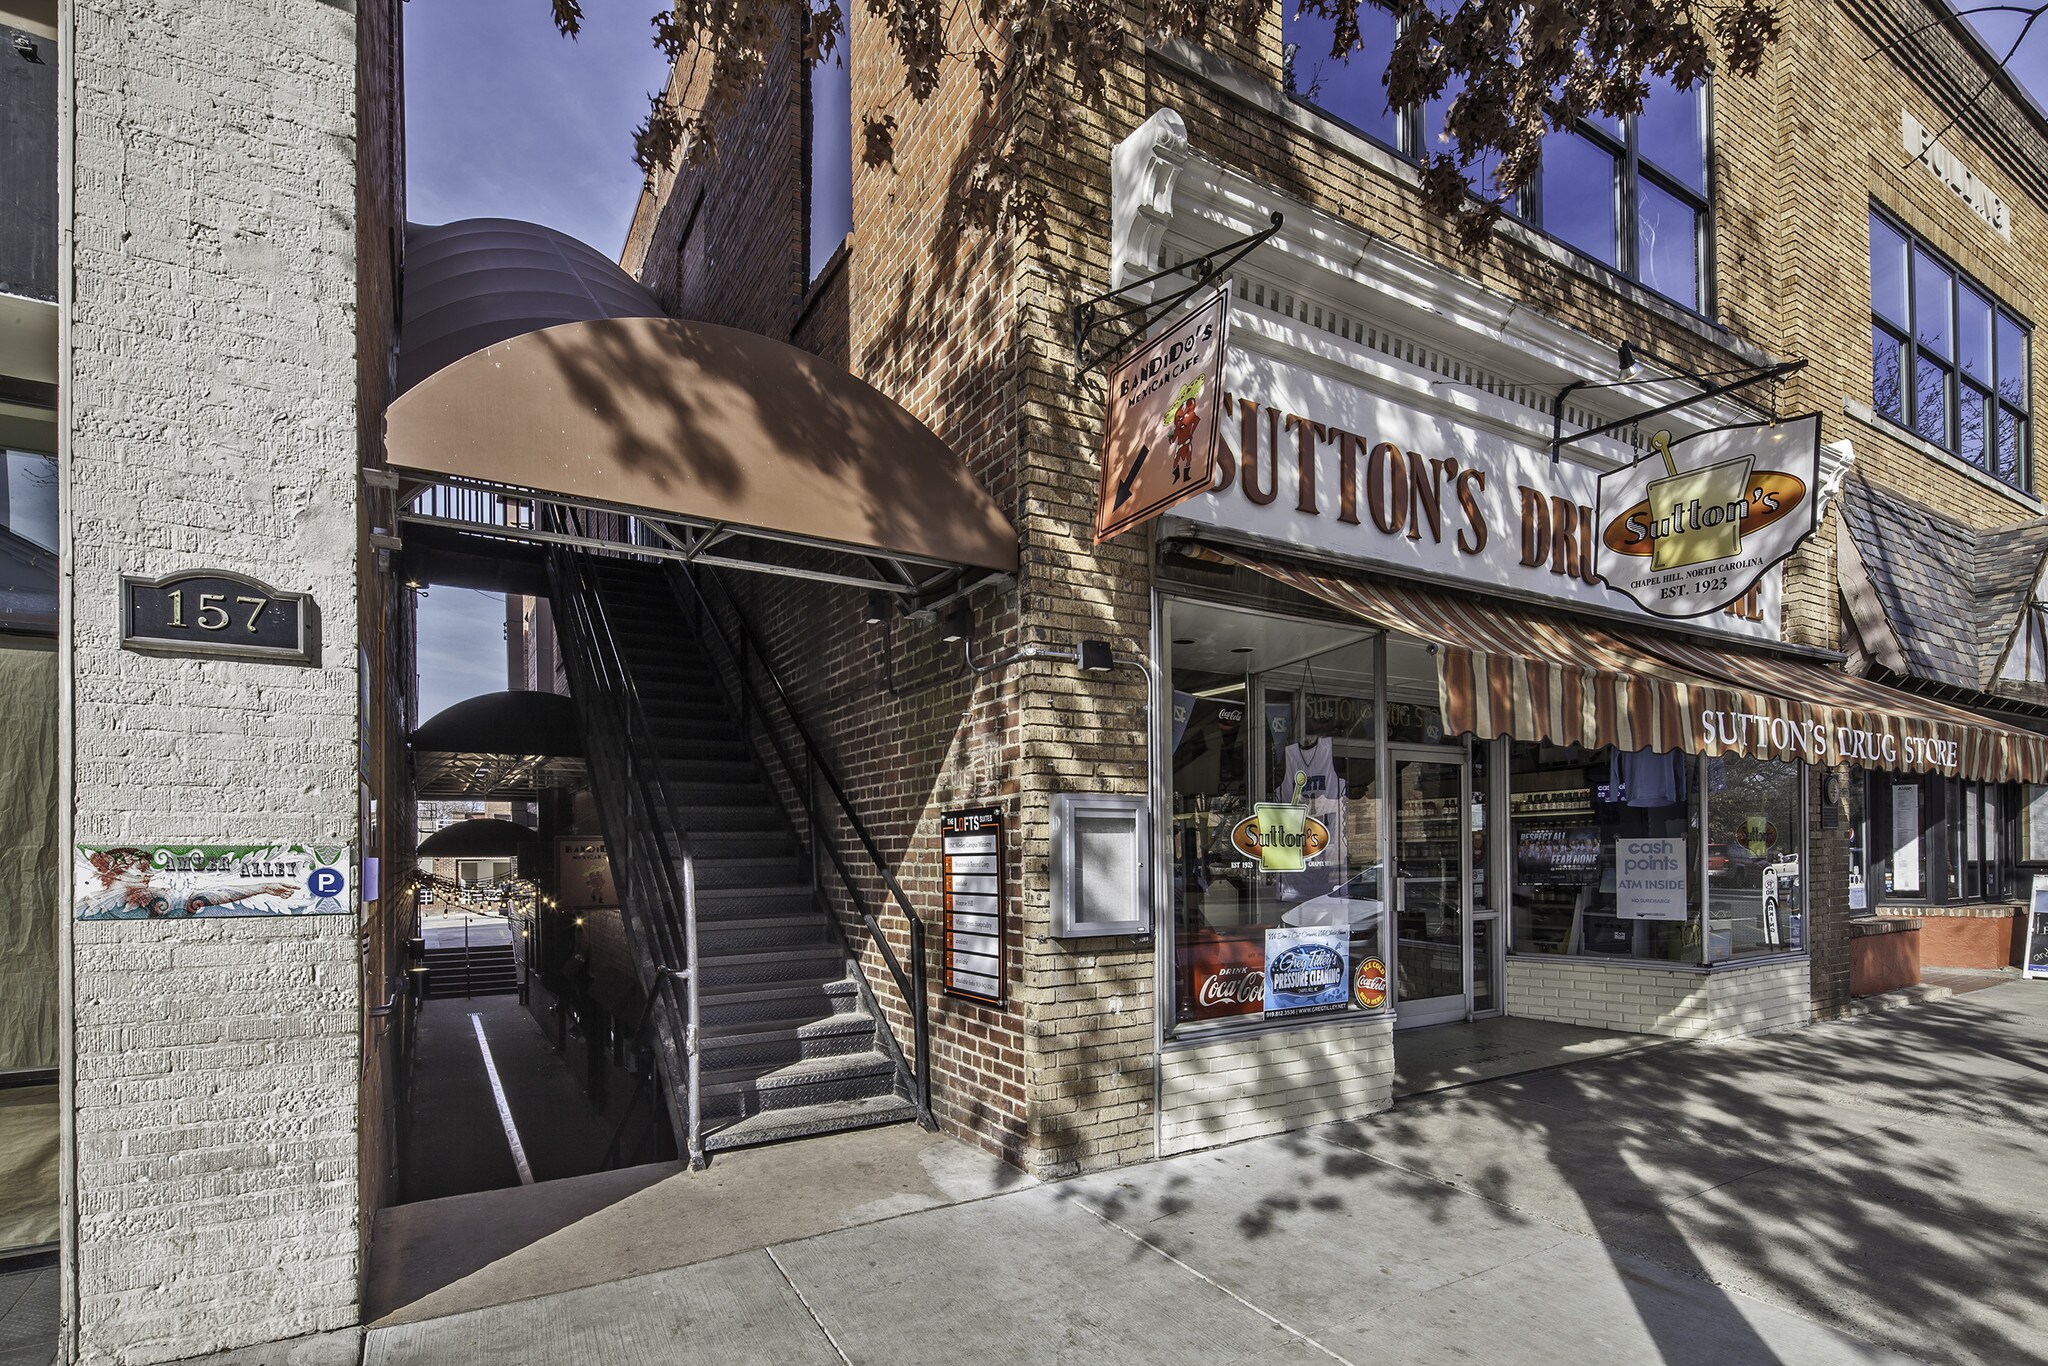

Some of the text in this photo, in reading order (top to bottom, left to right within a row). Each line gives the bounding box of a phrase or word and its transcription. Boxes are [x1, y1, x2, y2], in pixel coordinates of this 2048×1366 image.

[1120, 324, 1213, 399] BANDIDO'S
[1128, 354, 1200, 409] MEXICAN CAFE
[1624, 487, 1780, 545] Sutton's
[1630, 557, 1764, 589] CHAPEL HILL, NORTH CAROLINA
[1660, 577, 1728, 600] EST. 1923
[167, 589, 267, 633] 157
[1702, 709, 1958, 768] SUTTON'S DRUG STORE
[954, 815, 980, 831] LOFTS
[980, 814, 993, 822] SUITES
[1244, 824, 1319, 848] Sutton's
[1520, 832, 1553, 841] RESPECT
[1628, 840, 1673, 854] cash
[164, 856, 297, 878] AMBER ALLEY
[1551, 854, 1598, 864] FEAR NONE
[1624, 855, 1678, 875] points
[1618, 879, 1685, 890] ATM INSIDE
[1219, 967, 1248, 976] DRINK
[1280, 952, 1307, 974] Greg
[1363, 961, 1385, 975] ICE COLD
[1274, 968, 1340, 989] PRESSURE CLEANING
